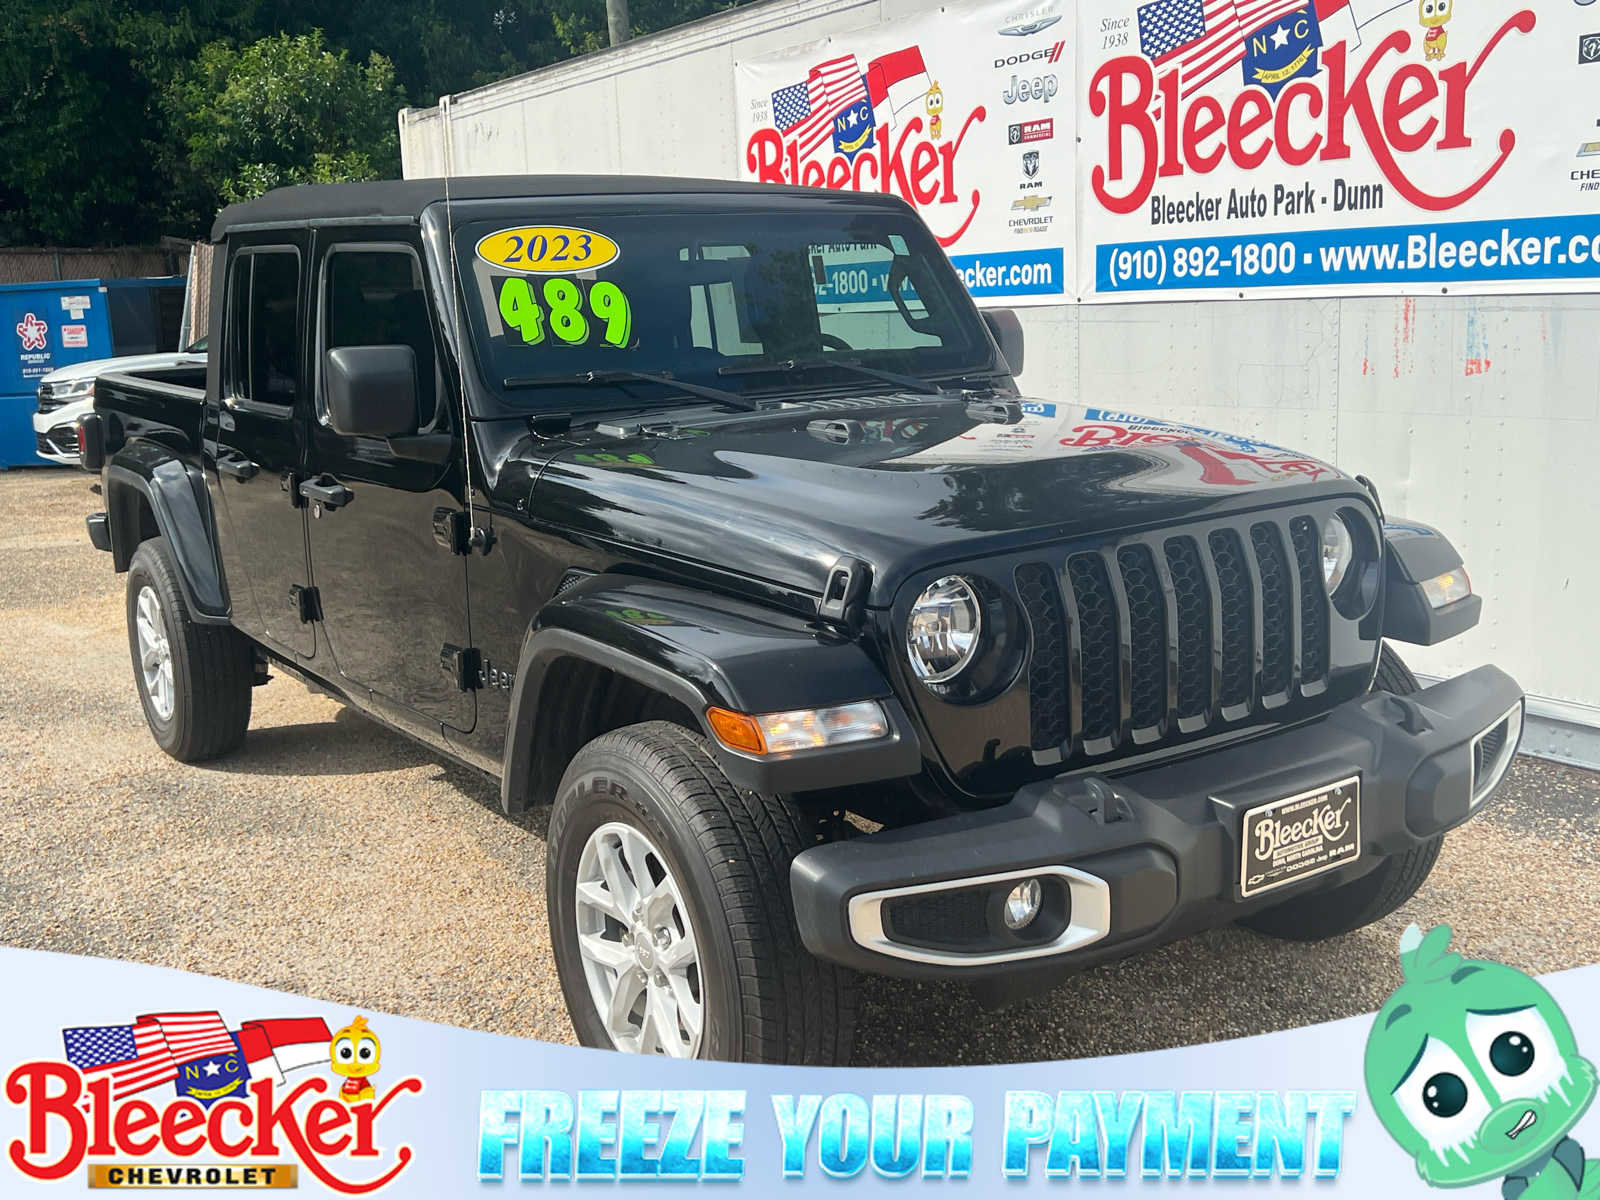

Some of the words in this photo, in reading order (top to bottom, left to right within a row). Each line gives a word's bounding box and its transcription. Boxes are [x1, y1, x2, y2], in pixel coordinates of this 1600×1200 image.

[1101, 17, 1130, 33] Since
[1102, 33, 1128, 50] 1938
[1253, 36, 1266, 57] N
[1294, 20, 1309, 38] C
[994, 47, 1056, 68] DODGE
[1003, 74, 1058, 104] Jeep
[752, 111, 768, 123] 1938
[1089, 9, 1536, 214] Bleecker
[1023, 122, 1051, 134] RAM
[1019, 181, 1043, 190] RAM
[1151, 186, 1221, 226] Bleecker
[1226, 188, 1267, 220] Auto
[1273, 184, 1316, 217] Park
[1334, 180, 1384, 212] Dunn
[1008, 215, 1053, 227] CHEVROLET
[503, 234, 593, 263] 2023
[1109, 247, 1167, 286] (910)
[1173, 242, 1296, 278] 892-1800
[499, 277, 632, 349] 489
[20, 352, 51, 361] REPUBLIC
[1254, 797, 1352, 861] Bleecker
[1329, 843, 1355, 857] RAM
